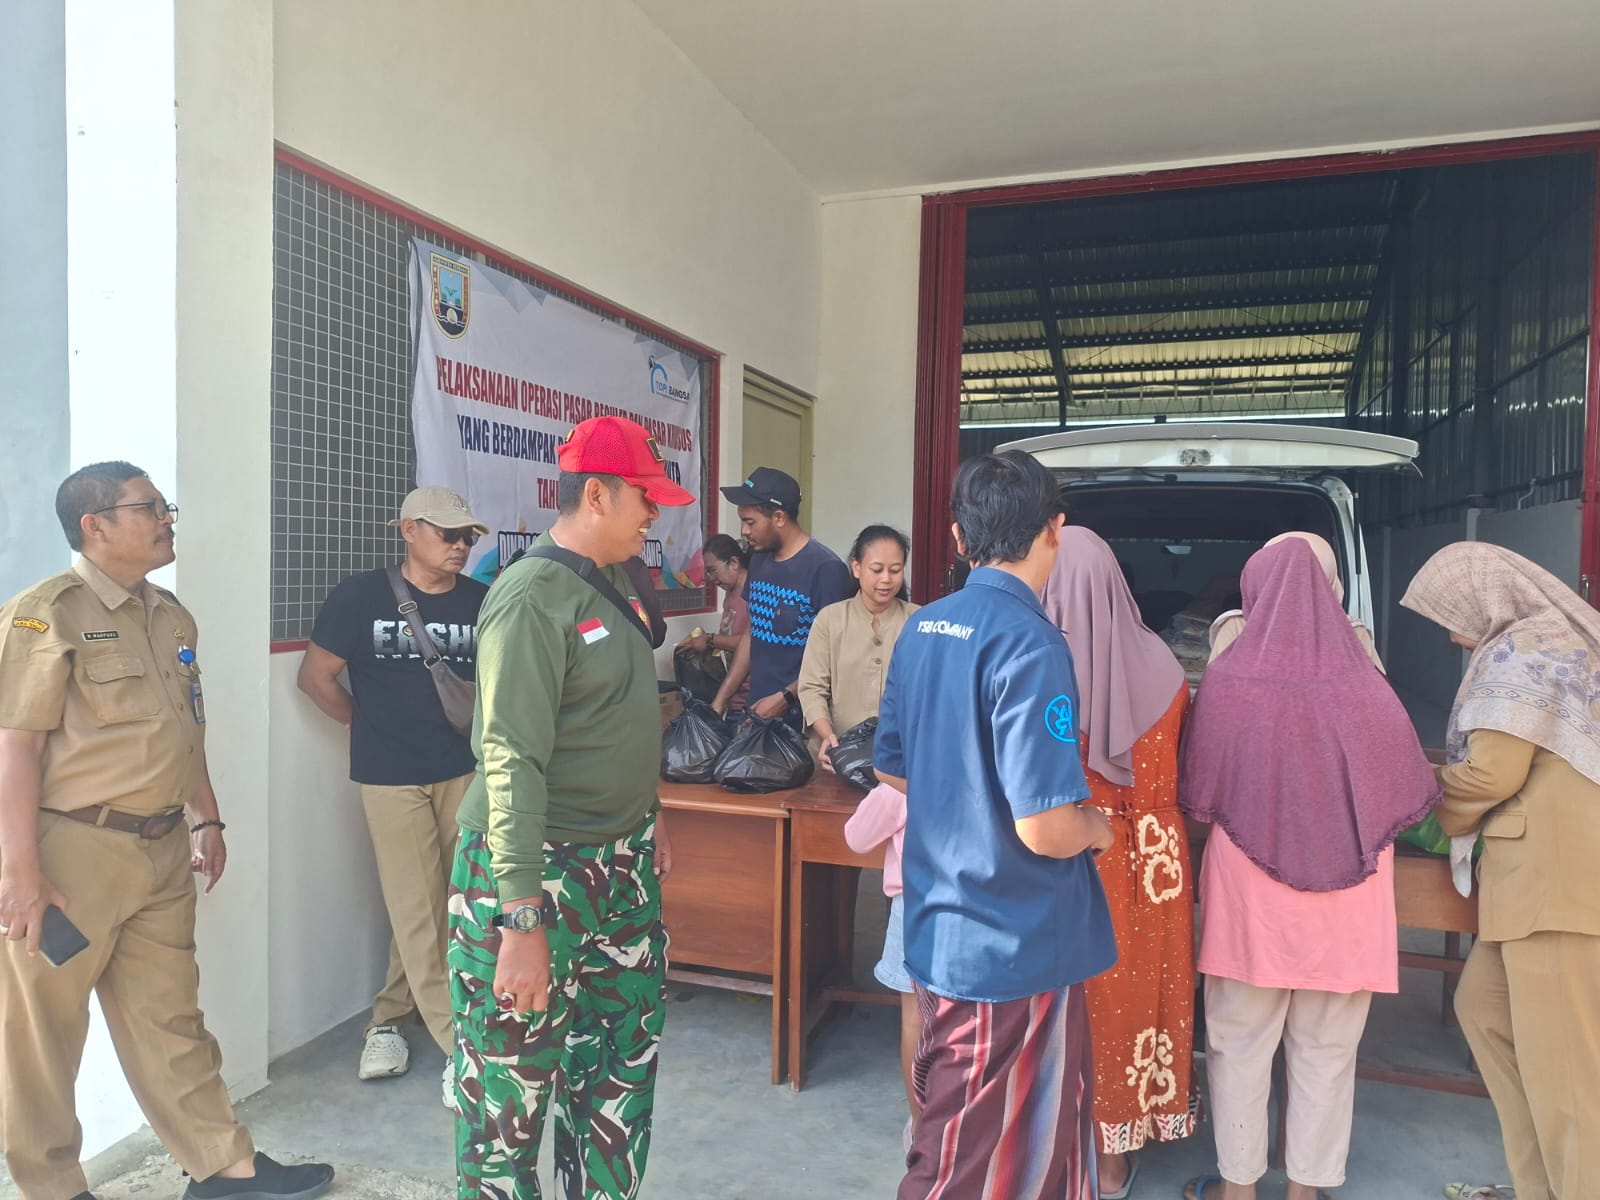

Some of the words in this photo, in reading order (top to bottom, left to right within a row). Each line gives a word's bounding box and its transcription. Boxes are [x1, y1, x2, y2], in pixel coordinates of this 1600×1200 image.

[435, 354, 518, 410] PELAKSANAAN
[521, 380, 562, 421] OPERASI
[564, 391, 593, 424] PASAR
[457, 413, 490, 453] YANG
[492, 421, 556, 465] BERDAMPAK
[932, 620, 975, 641] COMPANY
